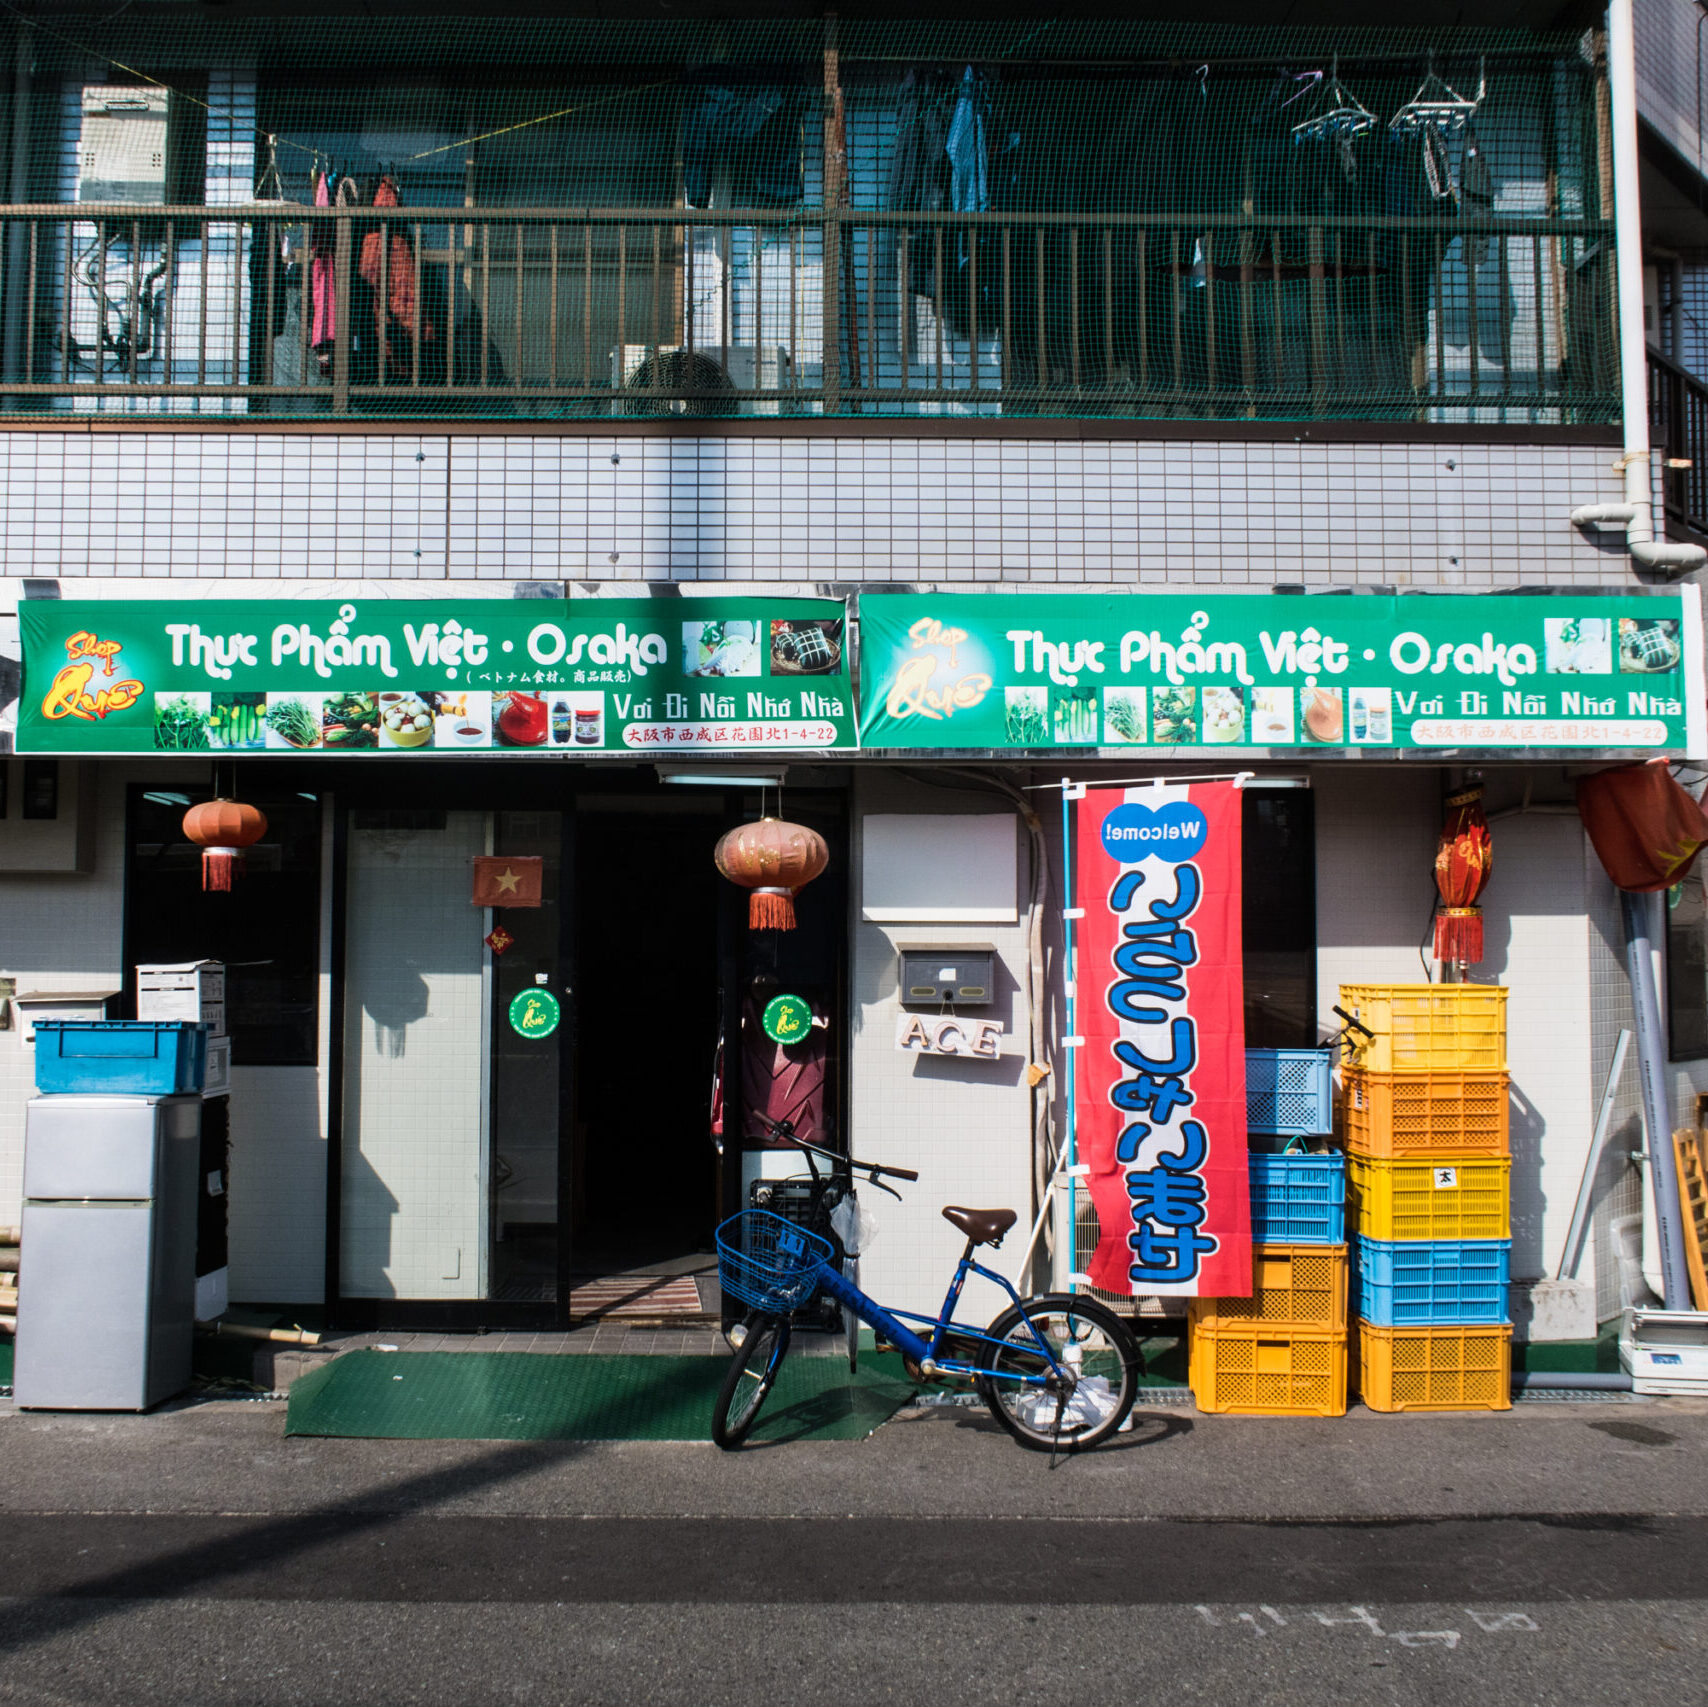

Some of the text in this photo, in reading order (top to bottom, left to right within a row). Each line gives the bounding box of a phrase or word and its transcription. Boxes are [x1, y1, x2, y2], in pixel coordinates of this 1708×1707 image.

[165, 603, 667, 681] Thực Phẩm Việt Osaka
[1005, 610, 1538, 688] Thực Phẩm Việt Osaka
[900, 1015, 1001, 1055] ACE
